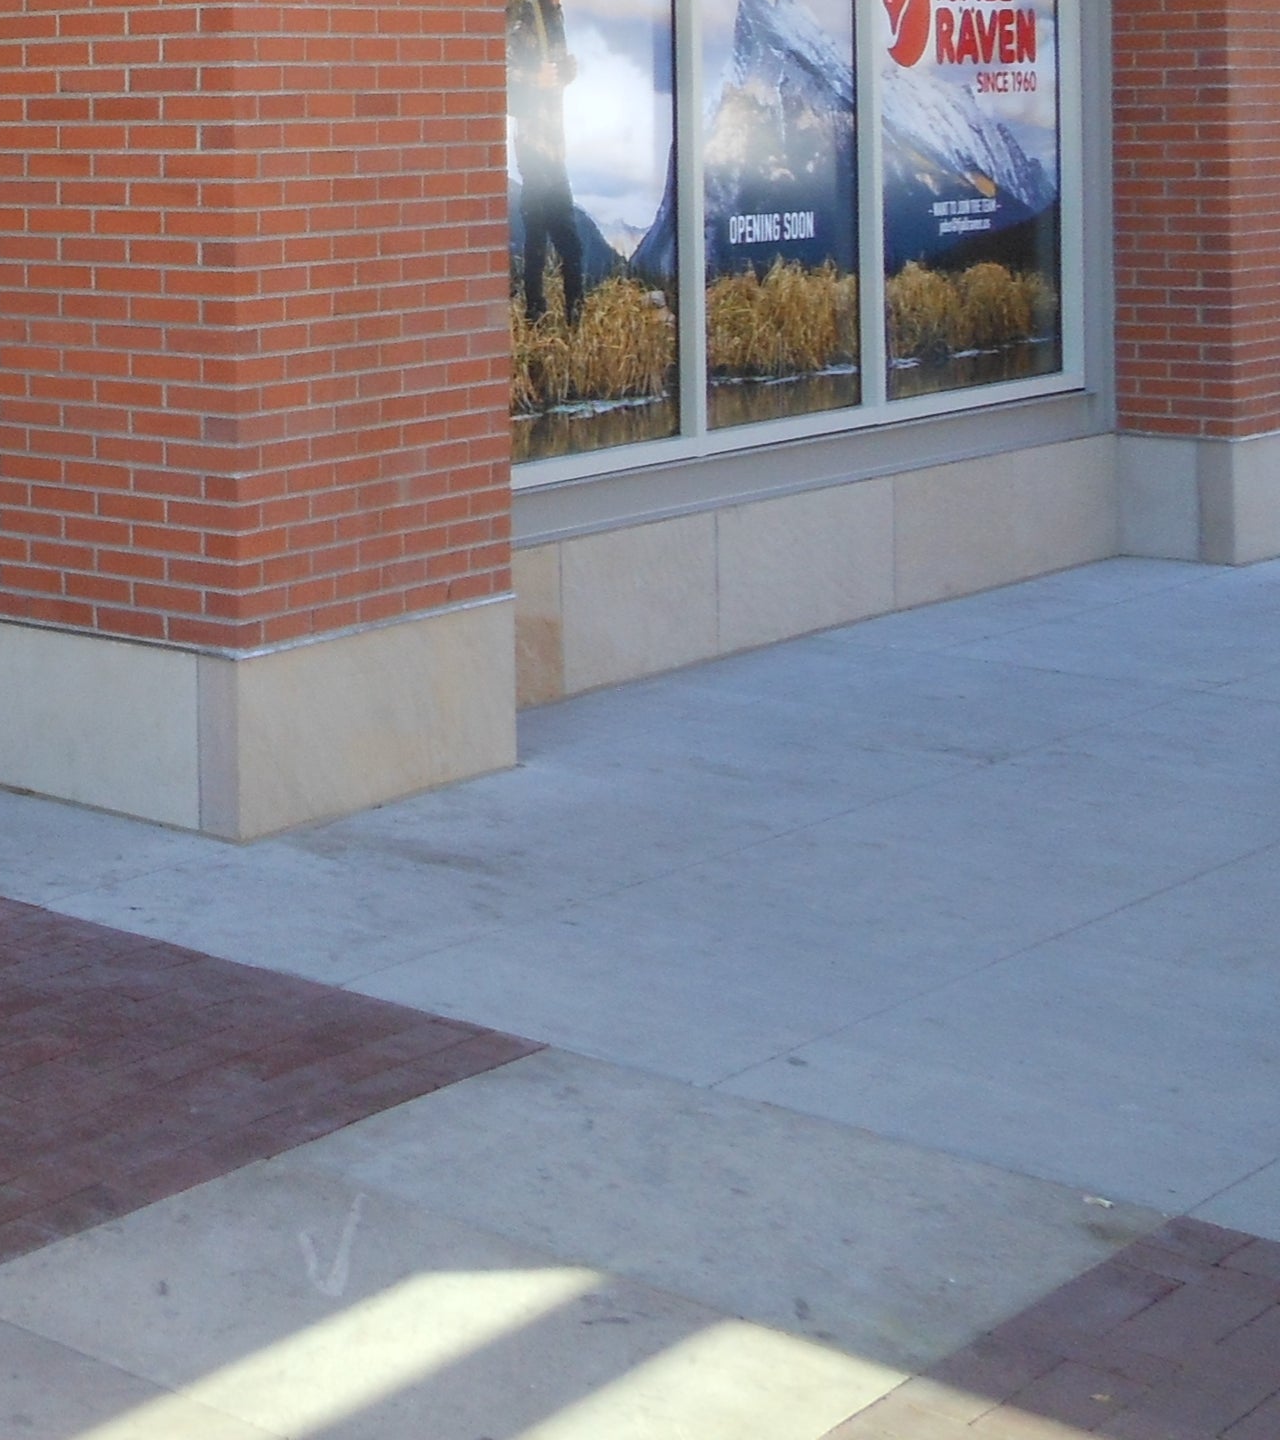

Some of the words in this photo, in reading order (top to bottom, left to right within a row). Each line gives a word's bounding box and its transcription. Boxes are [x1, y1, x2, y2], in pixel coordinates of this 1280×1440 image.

[977, 72, 1008, 93] SINCE
[1012, 71, 1037, 92] 1960
[729, 213, 780, 244] OPENING
[784, 211, 814, 240] SOON
